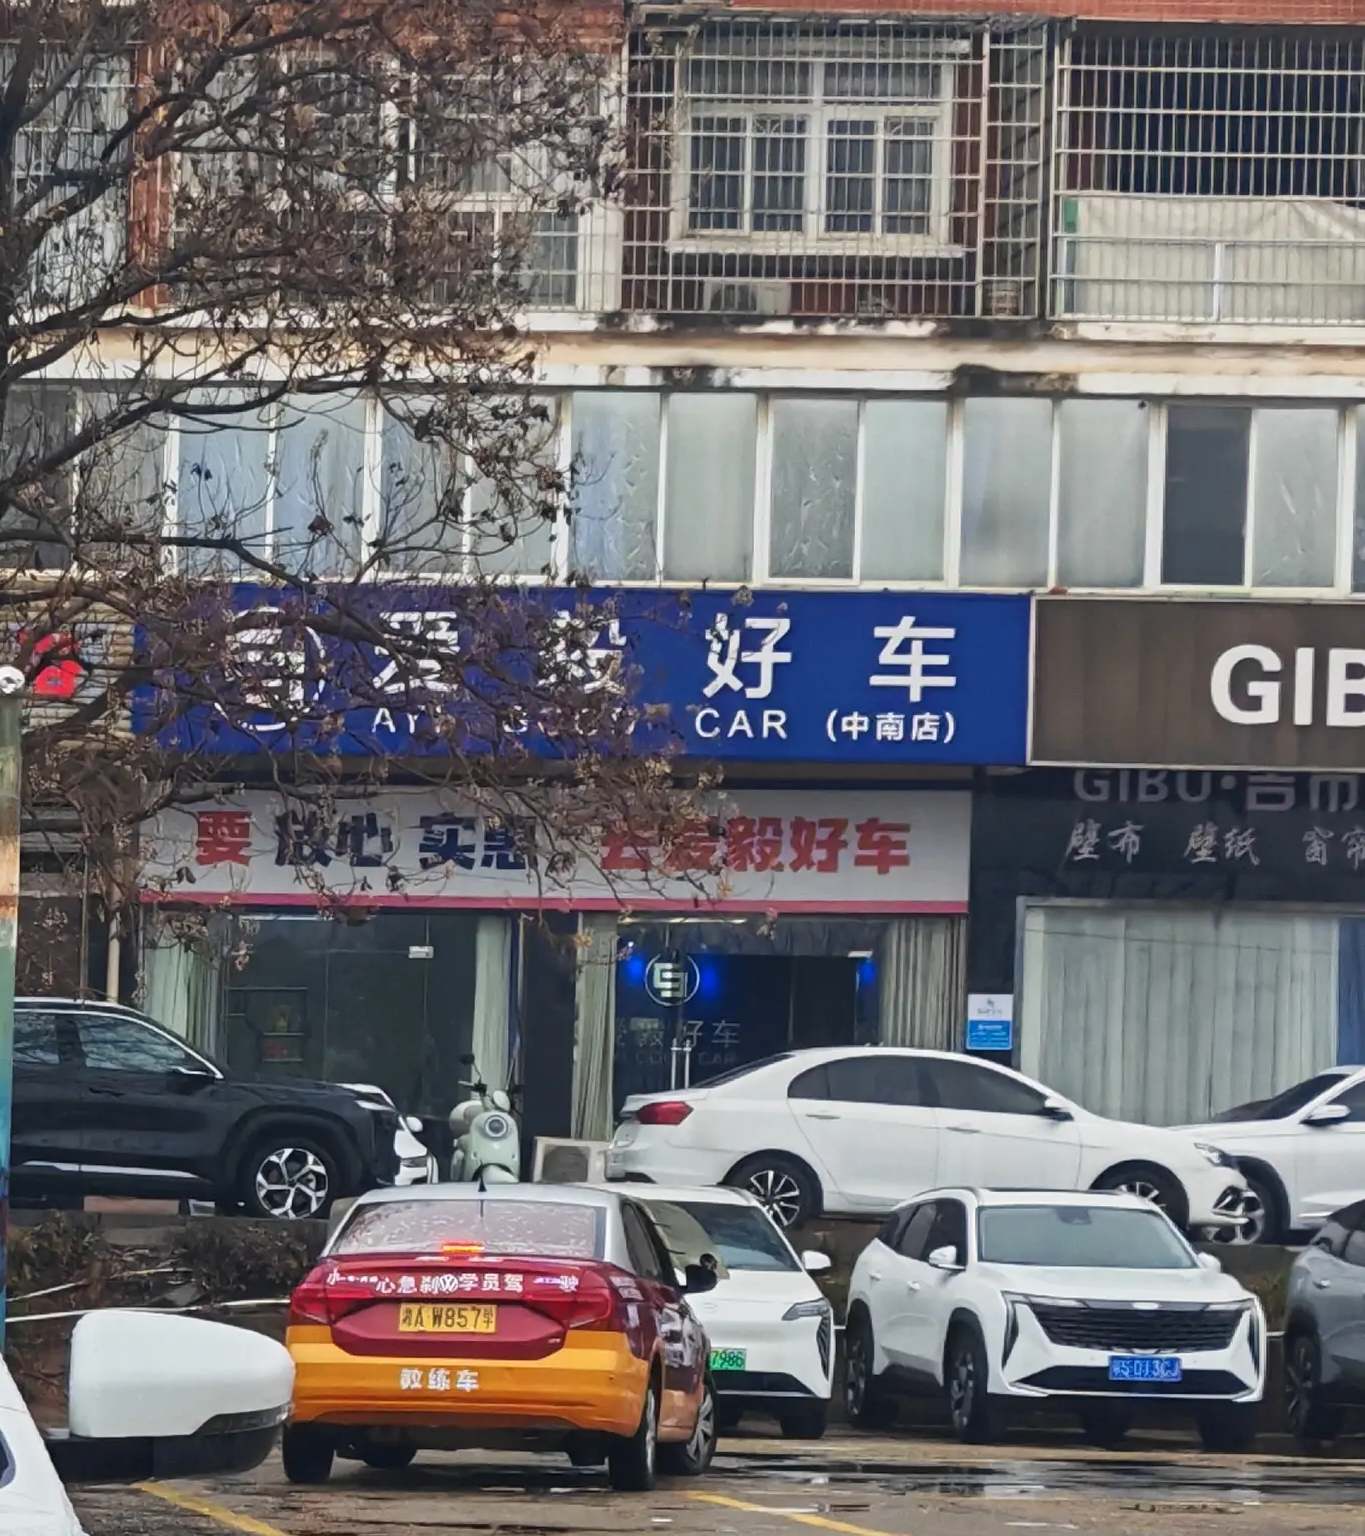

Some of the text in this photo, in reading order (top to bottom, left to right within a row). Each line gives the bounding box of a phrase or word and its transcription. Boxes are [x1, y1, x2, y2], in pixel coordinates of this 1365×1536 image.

[694, 709, 788, 739] CAR
[400, 1368, 479, 1391] 教练车
